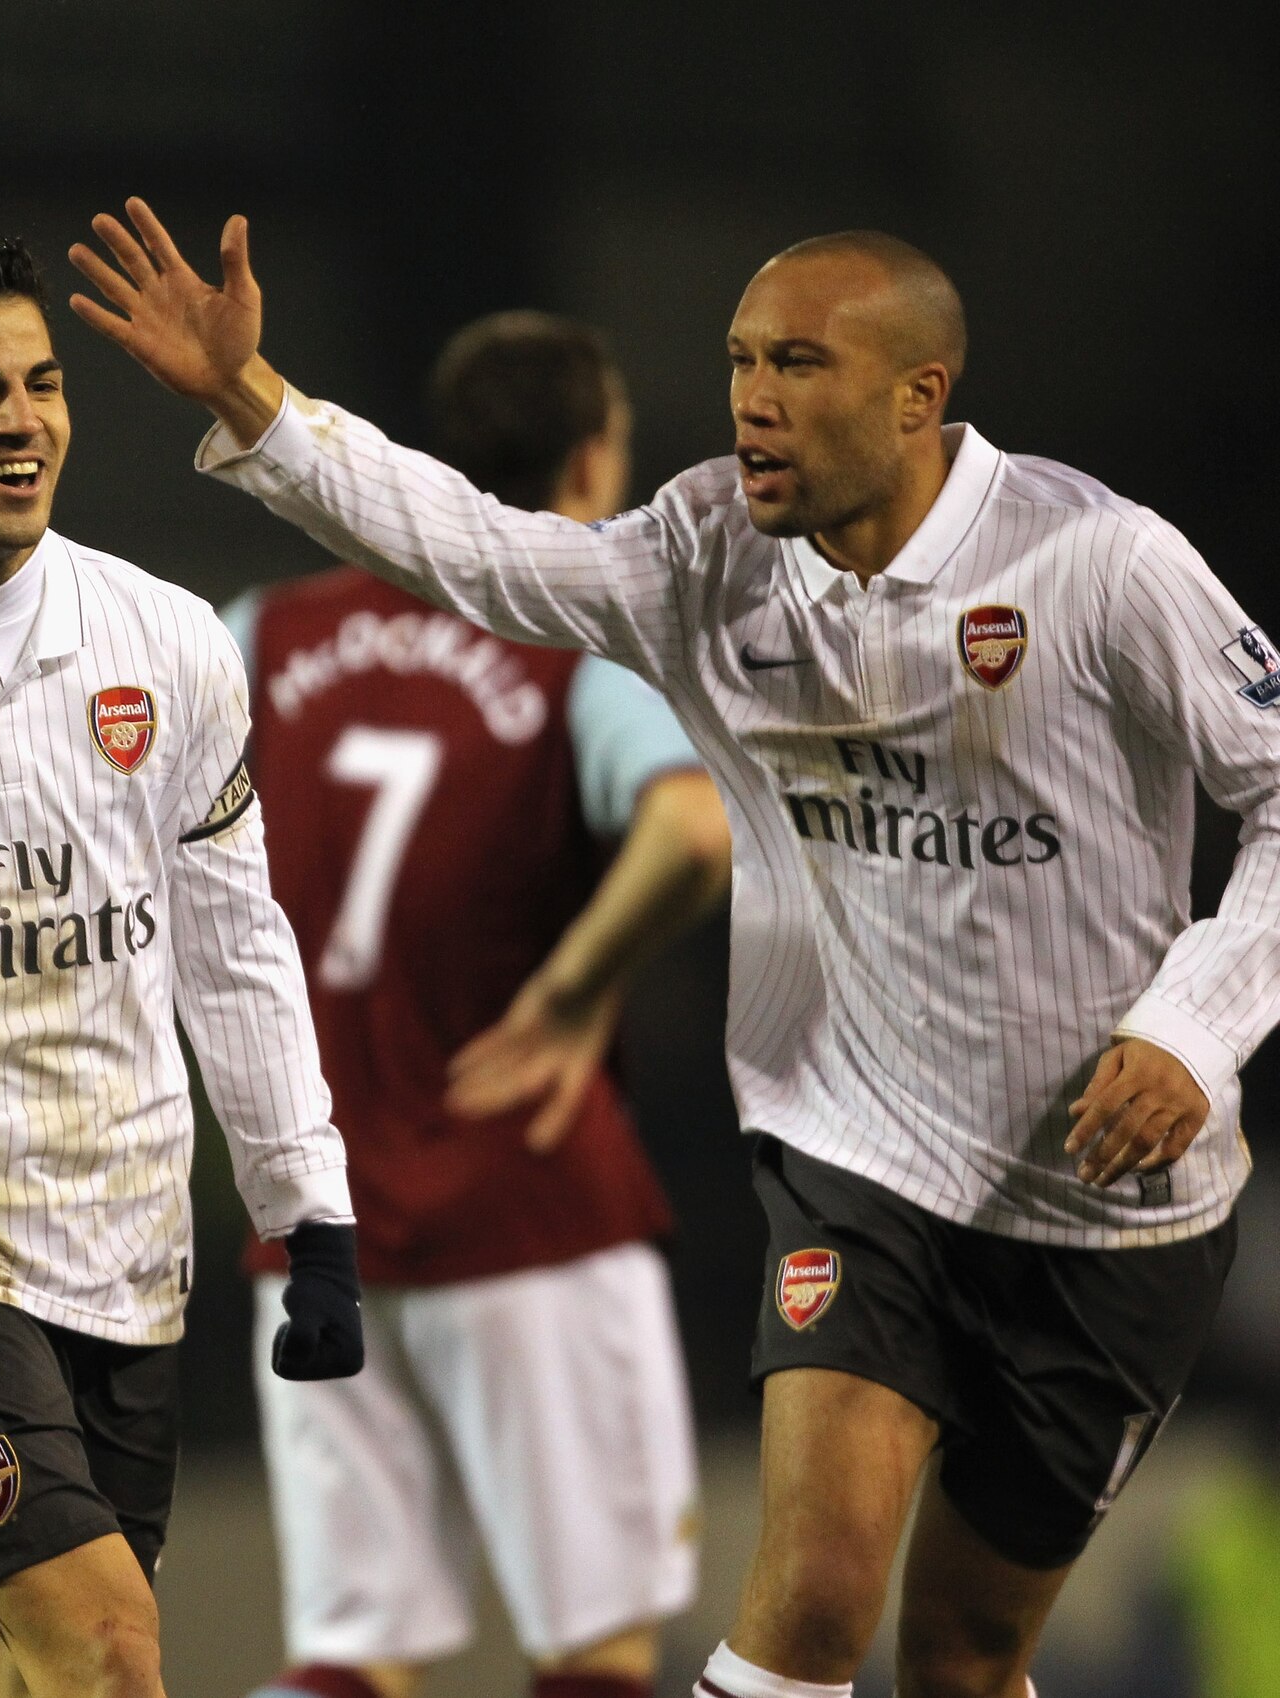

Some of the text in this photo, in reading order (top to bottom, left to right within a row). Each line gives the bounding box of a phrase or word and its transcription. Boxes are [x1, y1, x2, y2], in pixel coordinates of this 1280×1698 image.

[967, 618, 1017, 635] Arsenal
[1256, 674, 1280, 696] BARC
[99, 700, 146, 718] Arsenal
[832, 736, 926, 795] Fly
[787, 787, 1061, 870] mirates
[322, 722, 448, 992] 7
[785, 1261, 830, 1278] Arsenal
